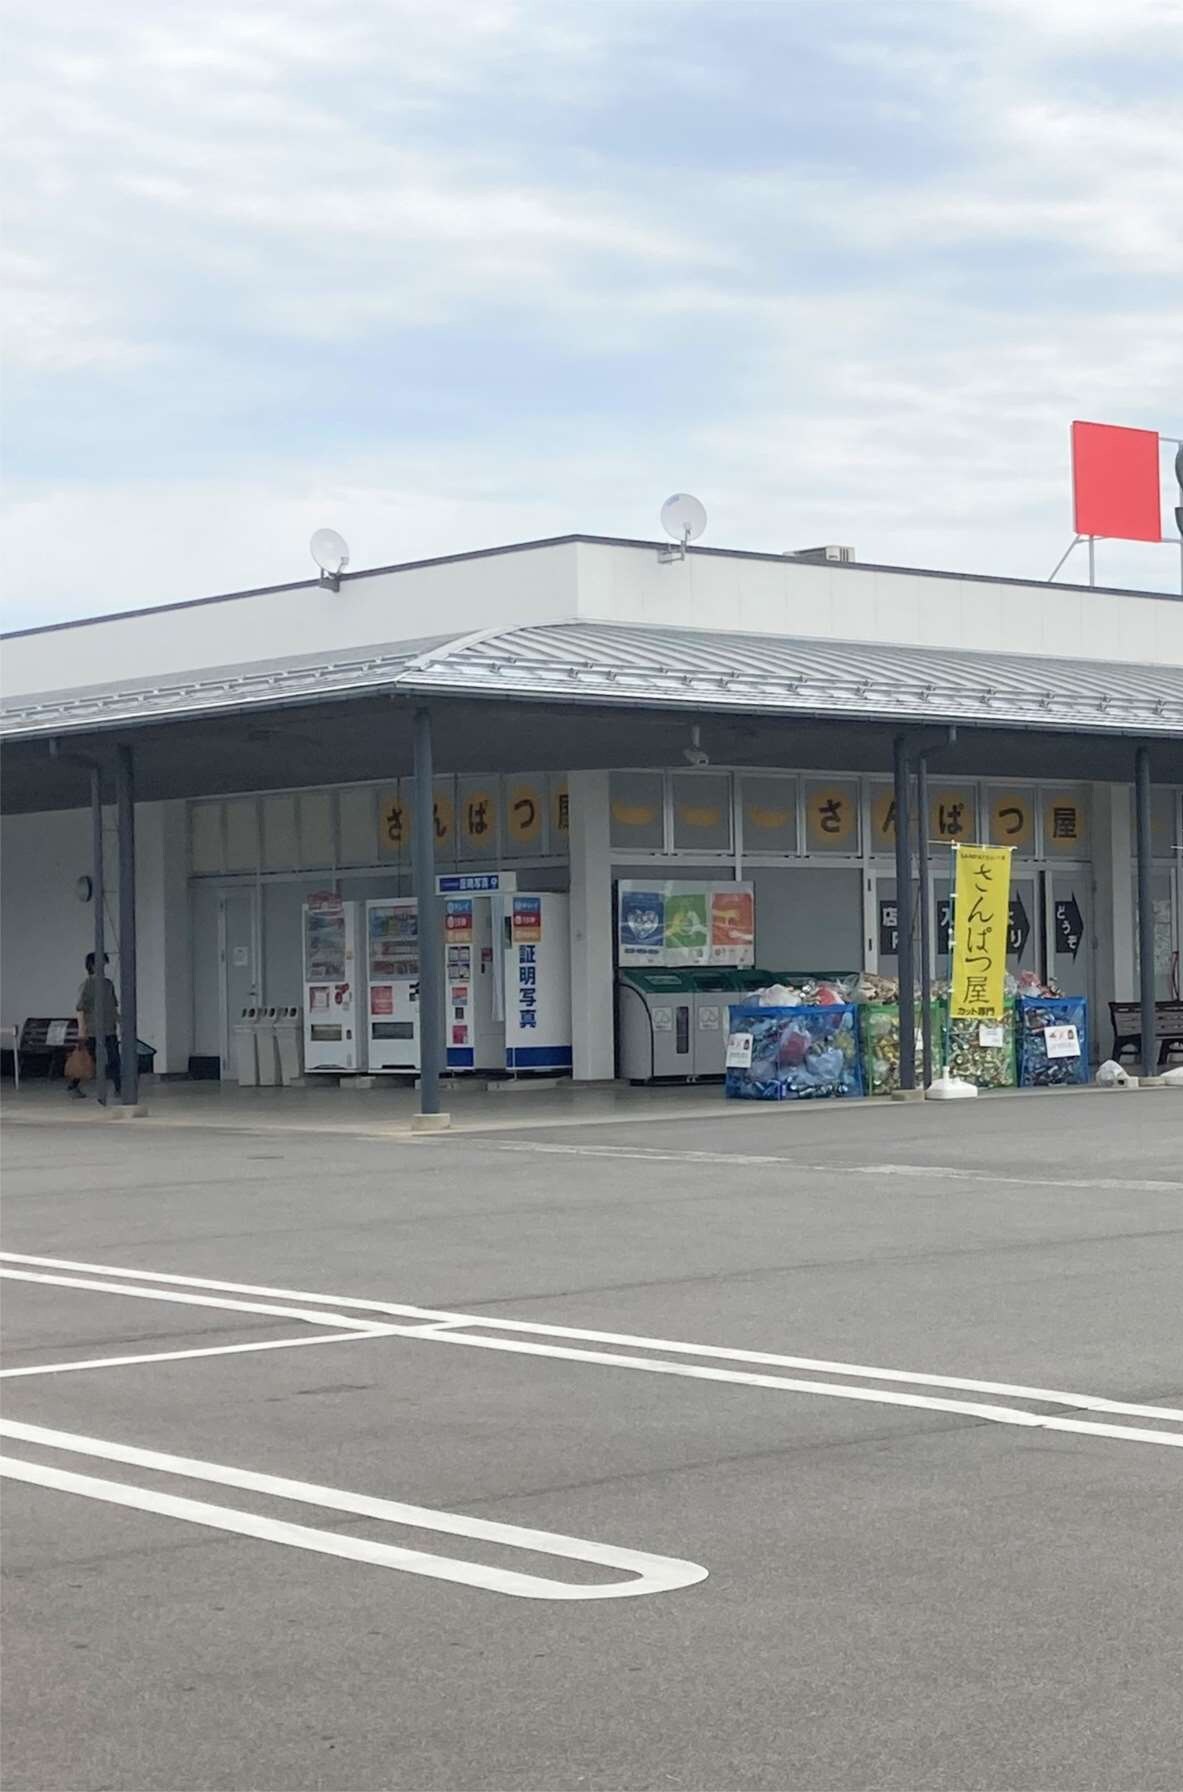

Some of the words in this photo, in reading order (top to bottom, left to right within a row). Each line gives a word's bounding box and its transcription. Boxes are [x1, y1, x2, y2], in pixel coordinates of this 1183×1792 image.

[964, 864, 994, 1004] さんぱつ屋
[519, 944, 537, 1029] 証明写真
[957, 1006, 995, 1017] カット専門
